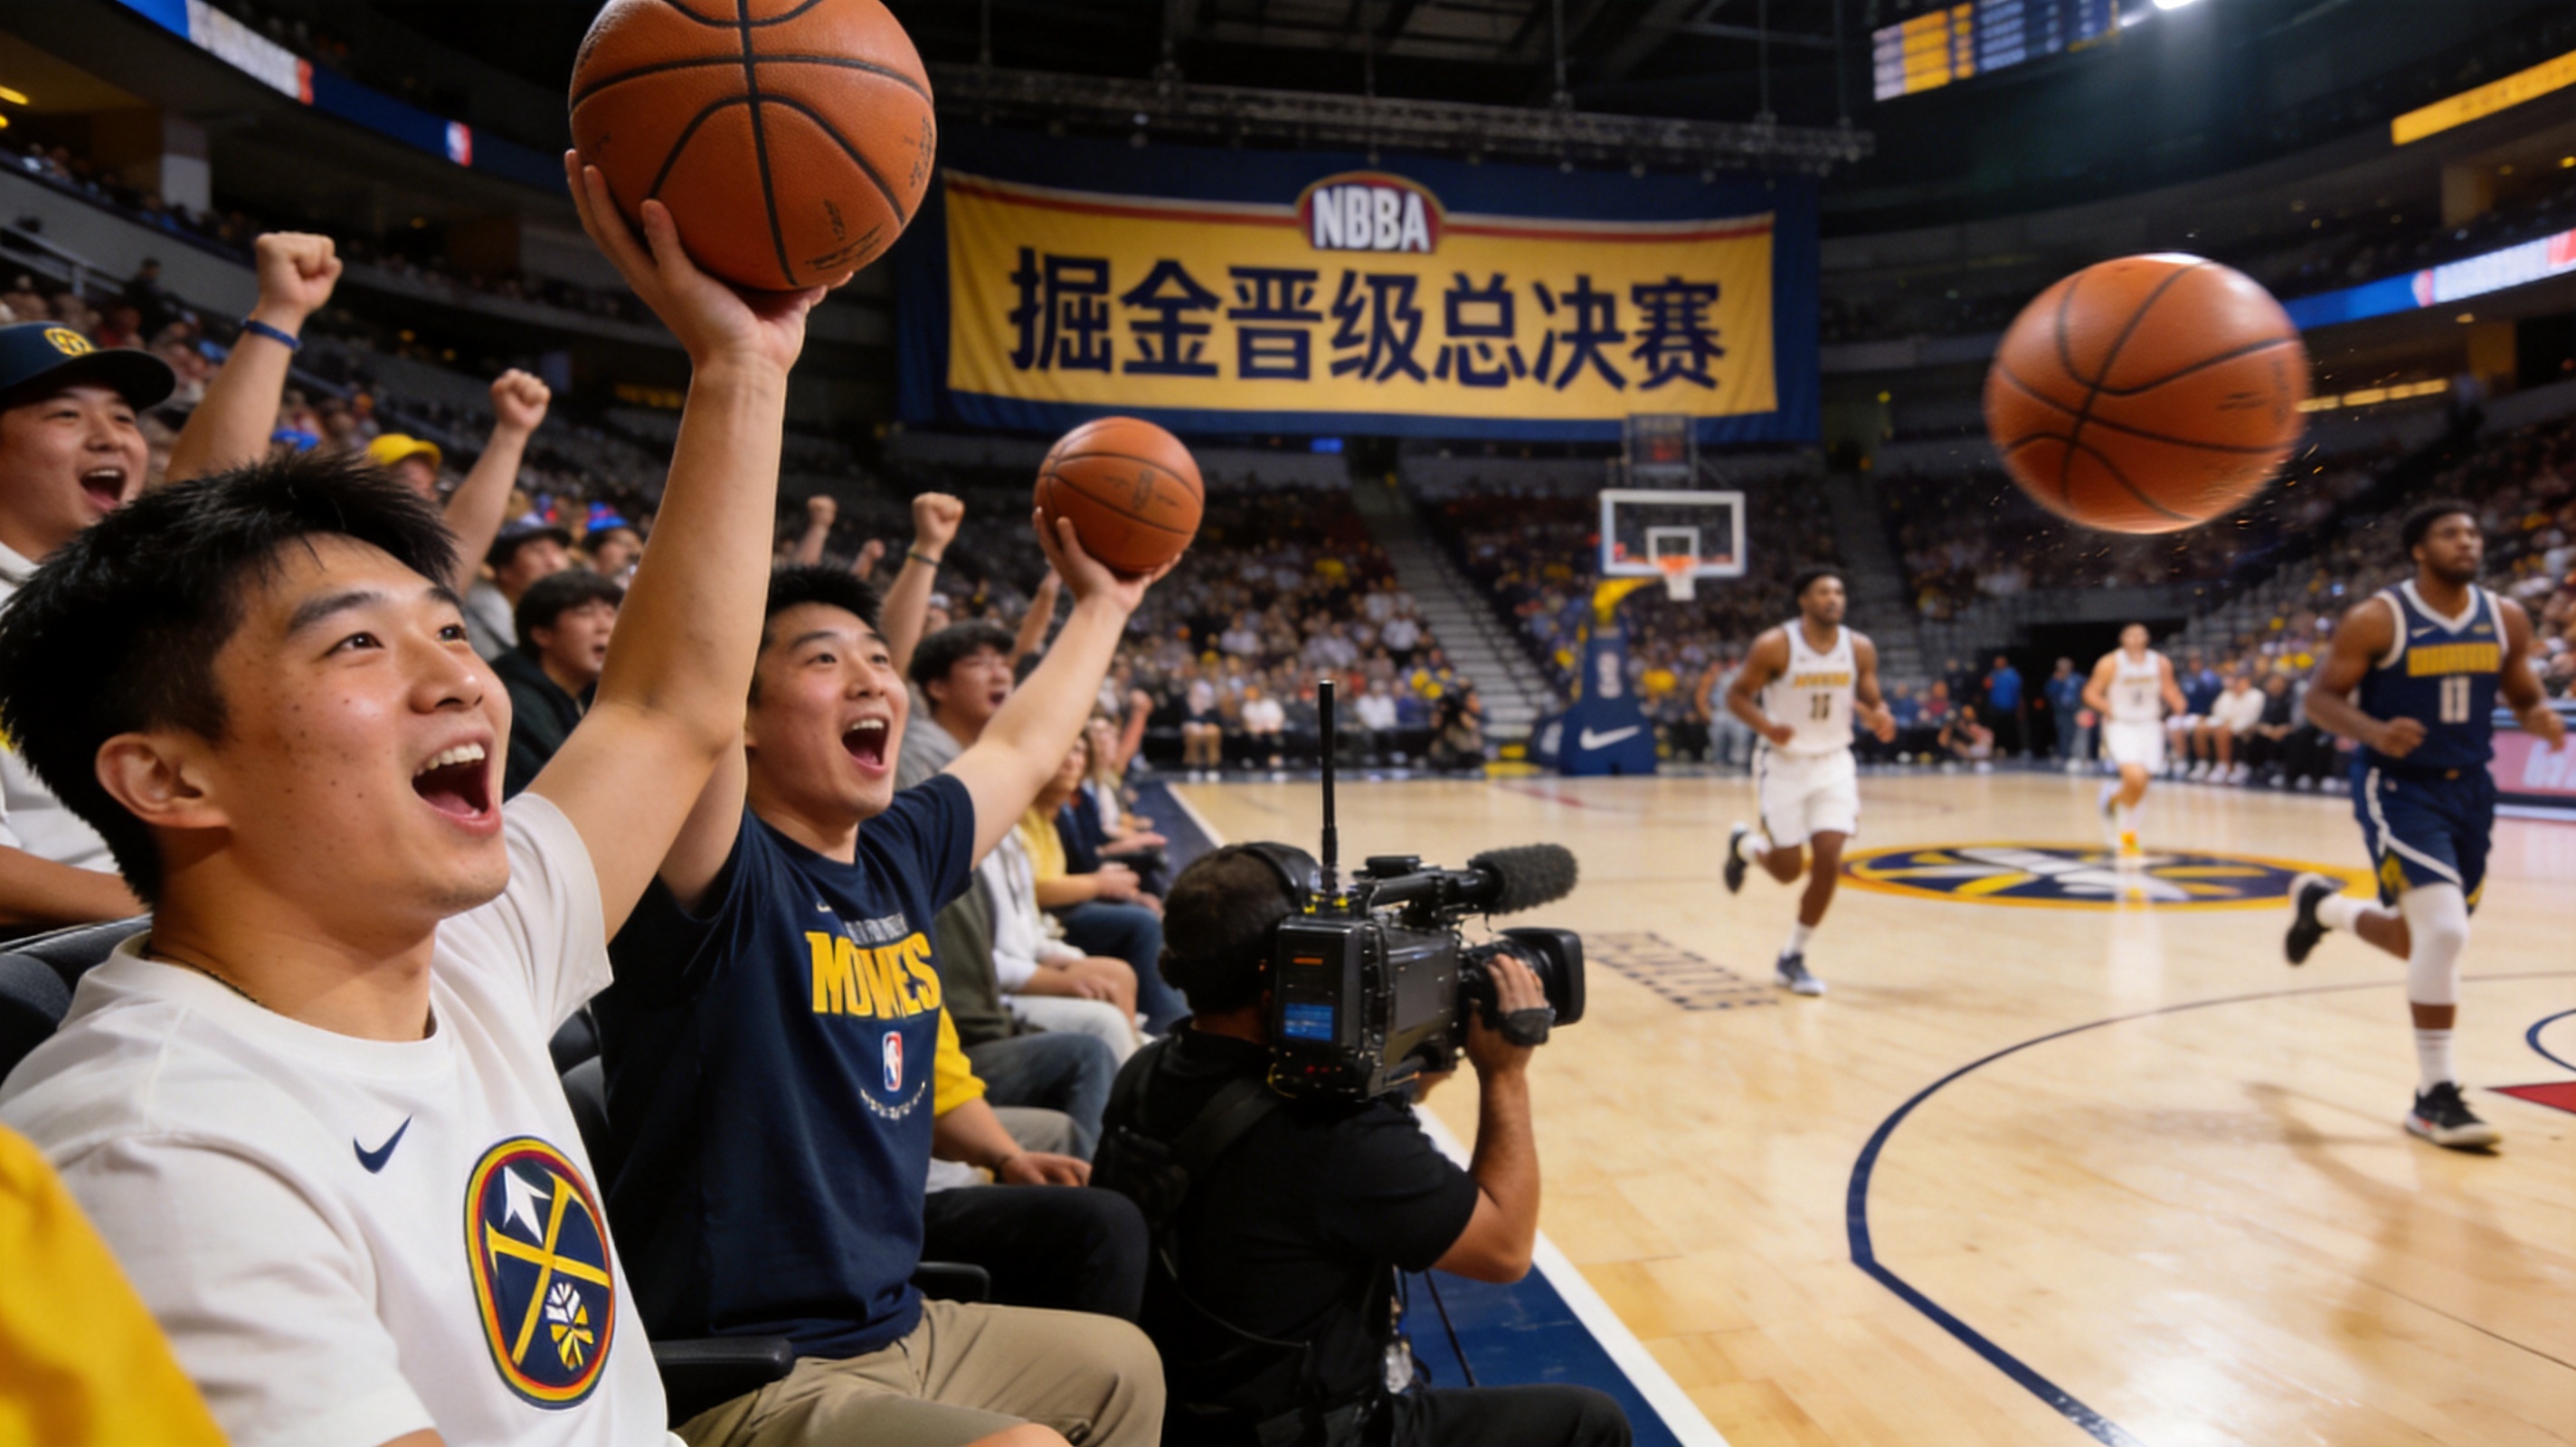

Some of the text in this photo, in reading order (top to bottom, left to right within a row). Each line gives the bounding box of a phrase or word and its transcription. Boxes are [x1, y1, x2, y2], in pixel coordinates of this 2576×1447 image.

[1313, 184, 1431, 253] NBBA
[1009, 246, 1725, 392] 掘金晋级总决赛
